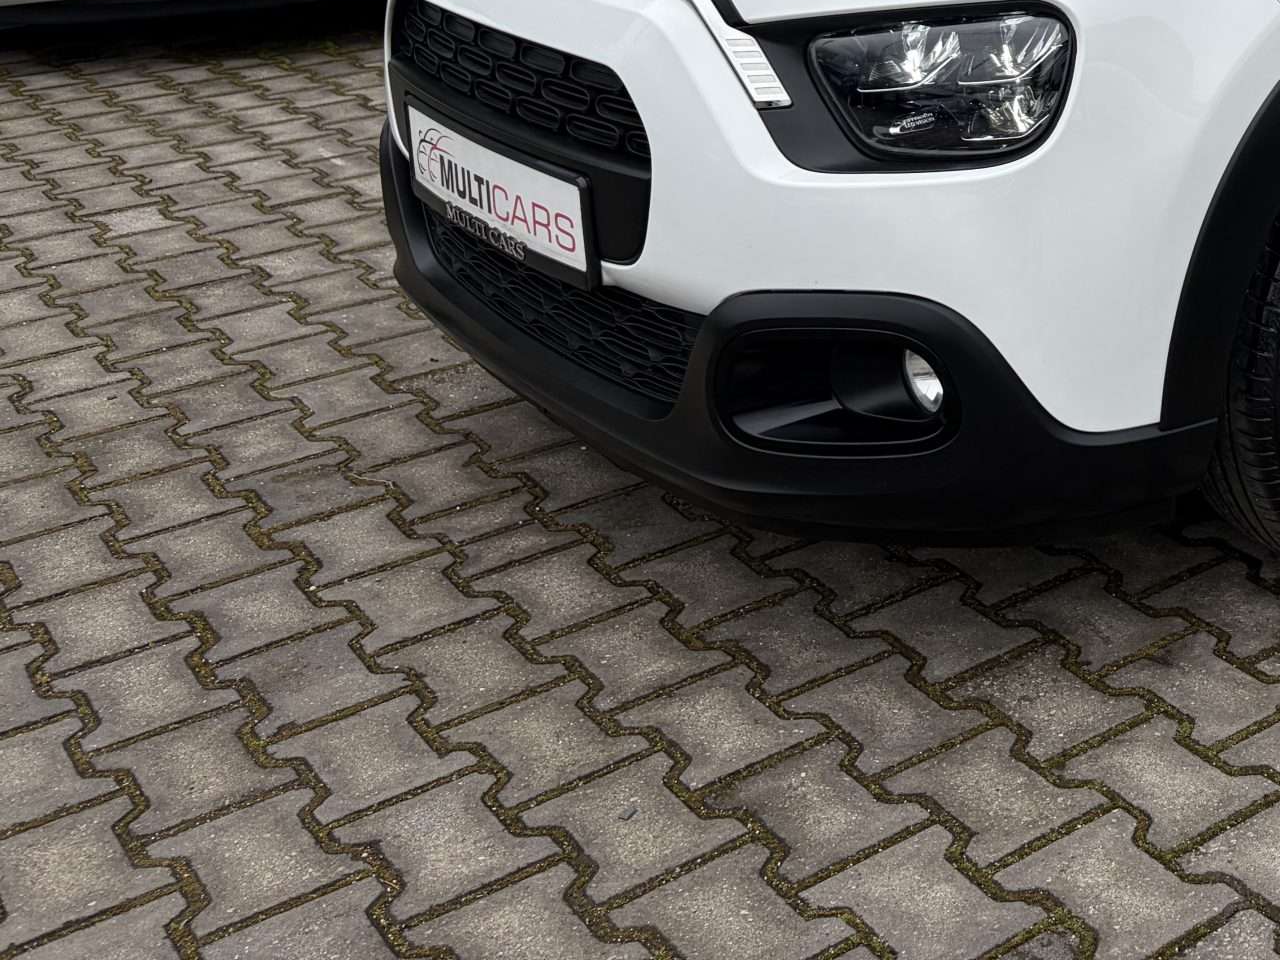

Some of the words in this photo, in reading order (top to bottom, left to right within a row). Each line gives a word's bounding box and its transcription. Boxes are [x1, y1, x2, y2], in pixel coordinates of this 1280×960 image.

[439, 153, 577, 253] MULTICARS
[447, 203, 488, 239] MULTI
[488, 226, 527, 261] CARS
